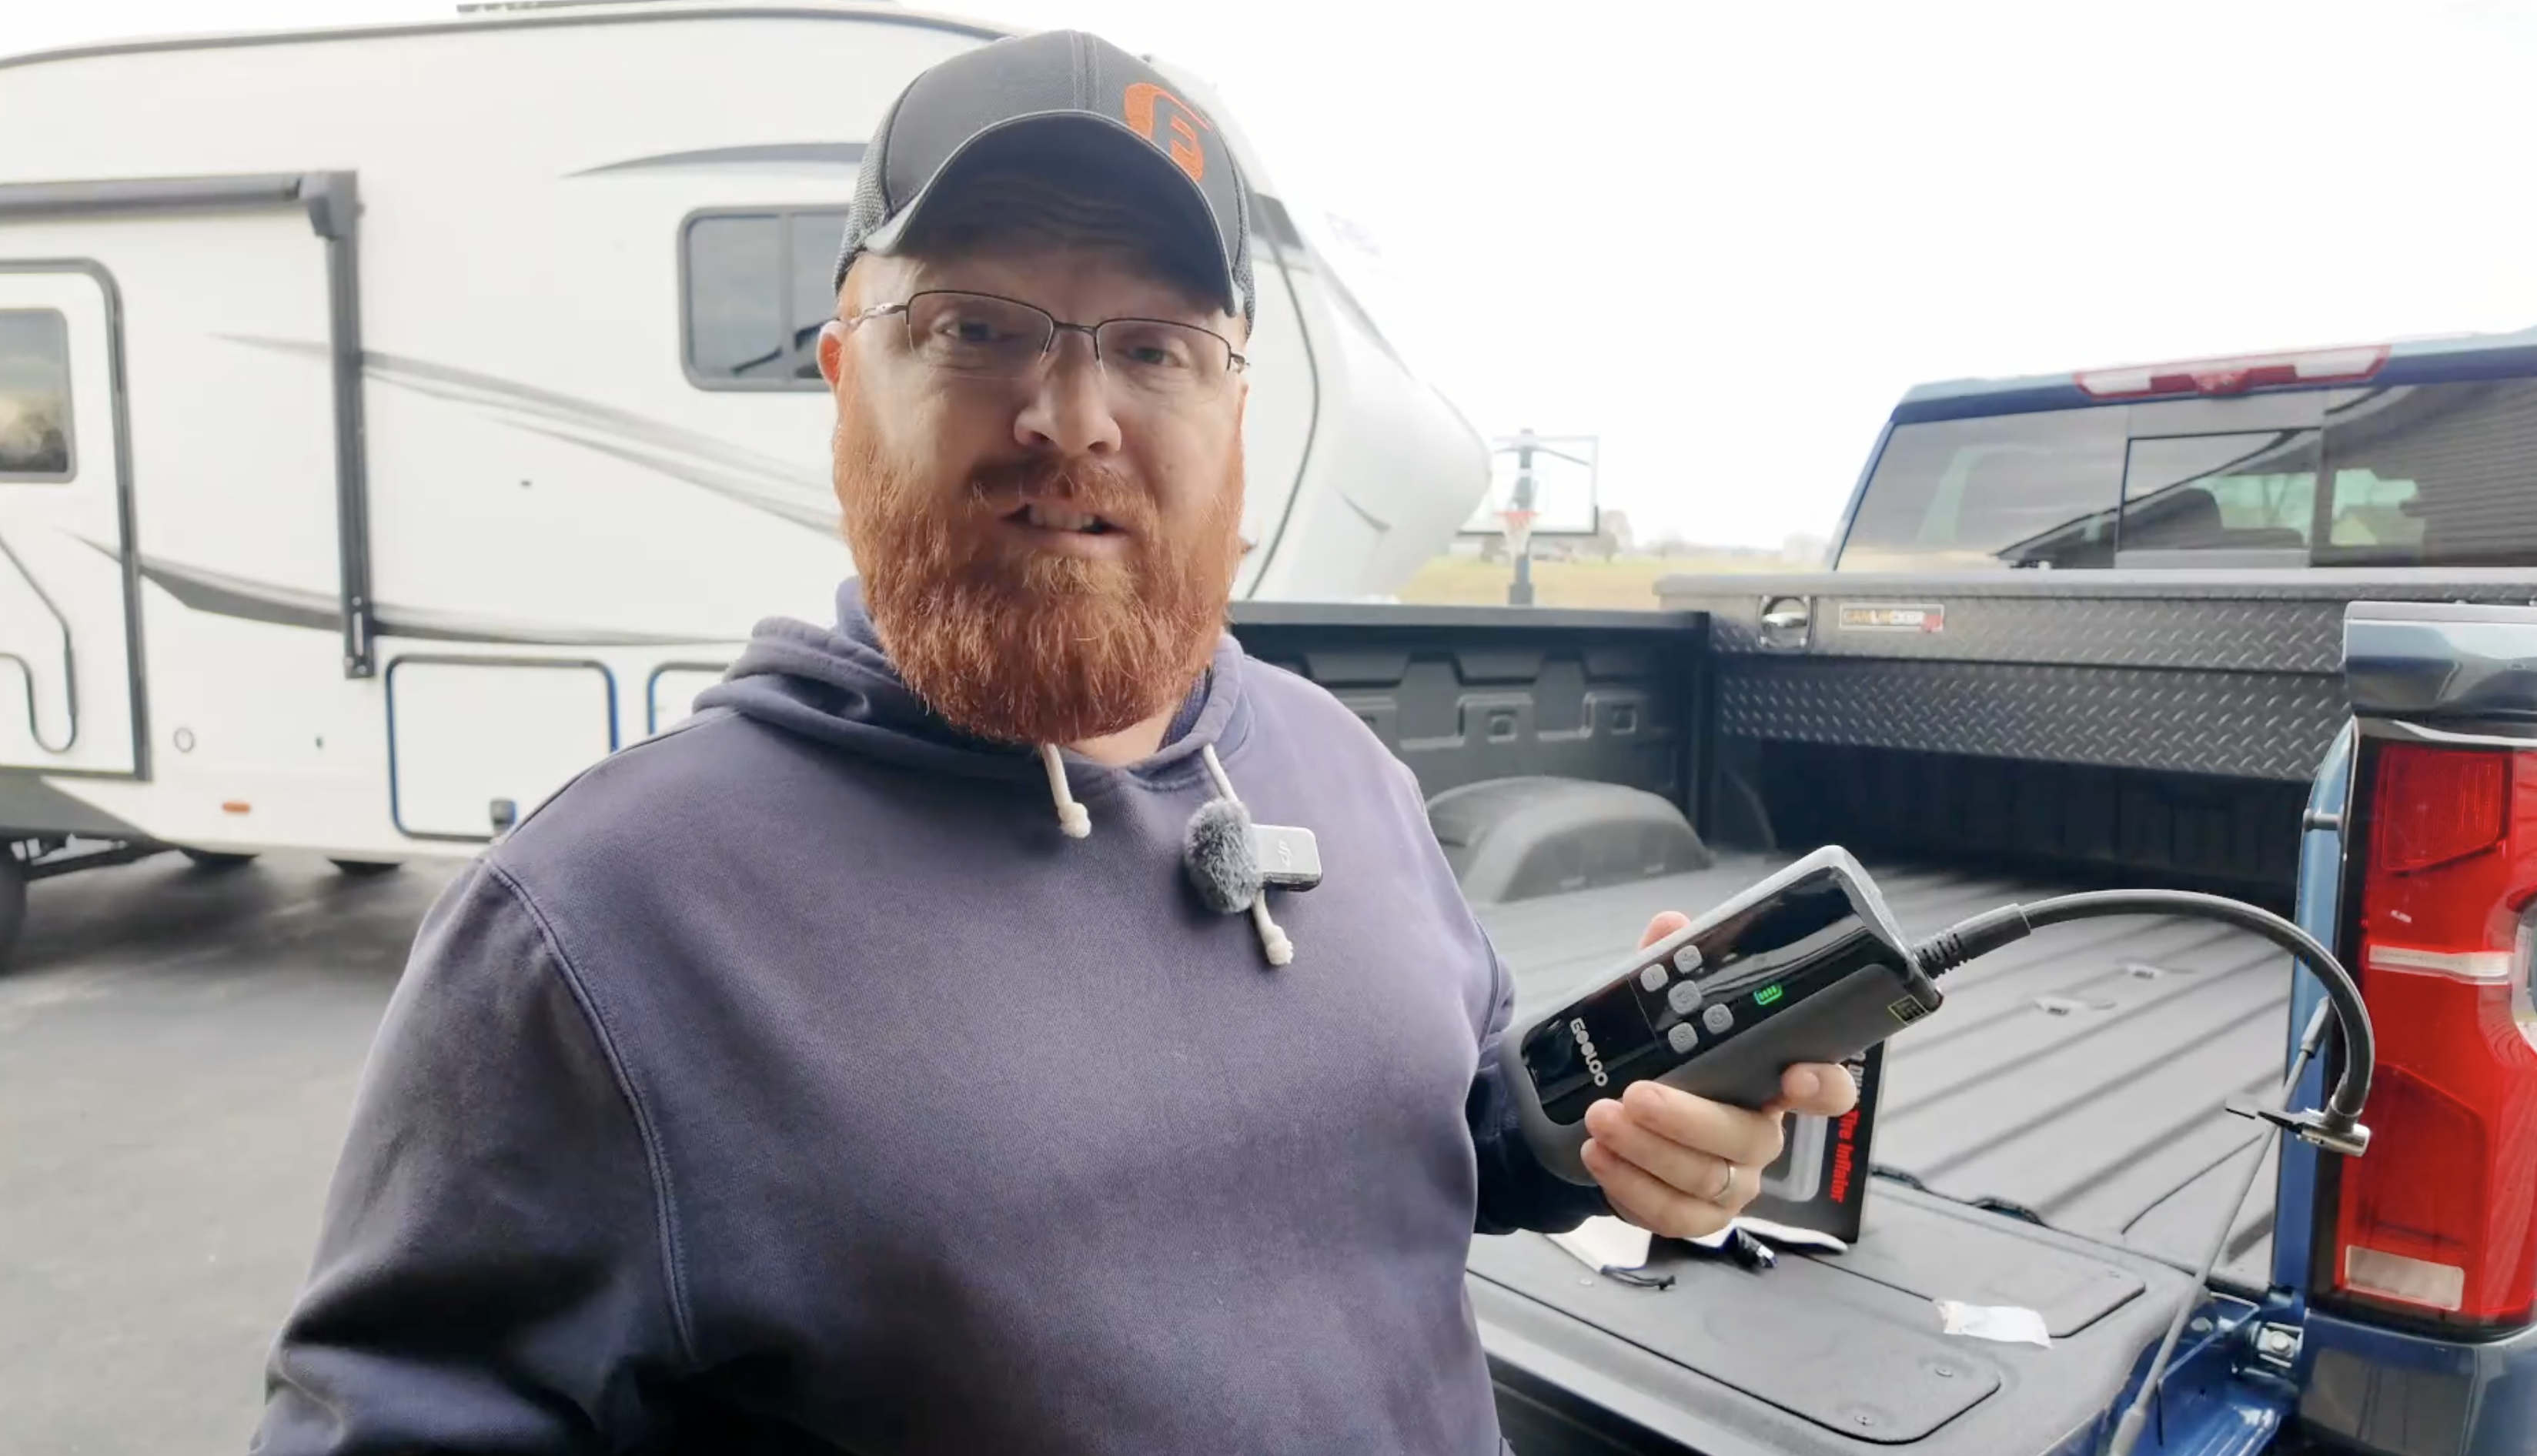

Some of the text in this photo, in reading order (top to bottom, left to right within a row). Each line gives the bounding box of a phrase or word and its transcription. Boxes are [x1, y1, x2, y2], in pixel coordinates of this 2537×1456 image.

[1569, 1017, 1609, 1087] GOOLOO
[1838, 1109, 1860, 1139] Tire
[1830, 1144, 1853, 1204] Inflator
